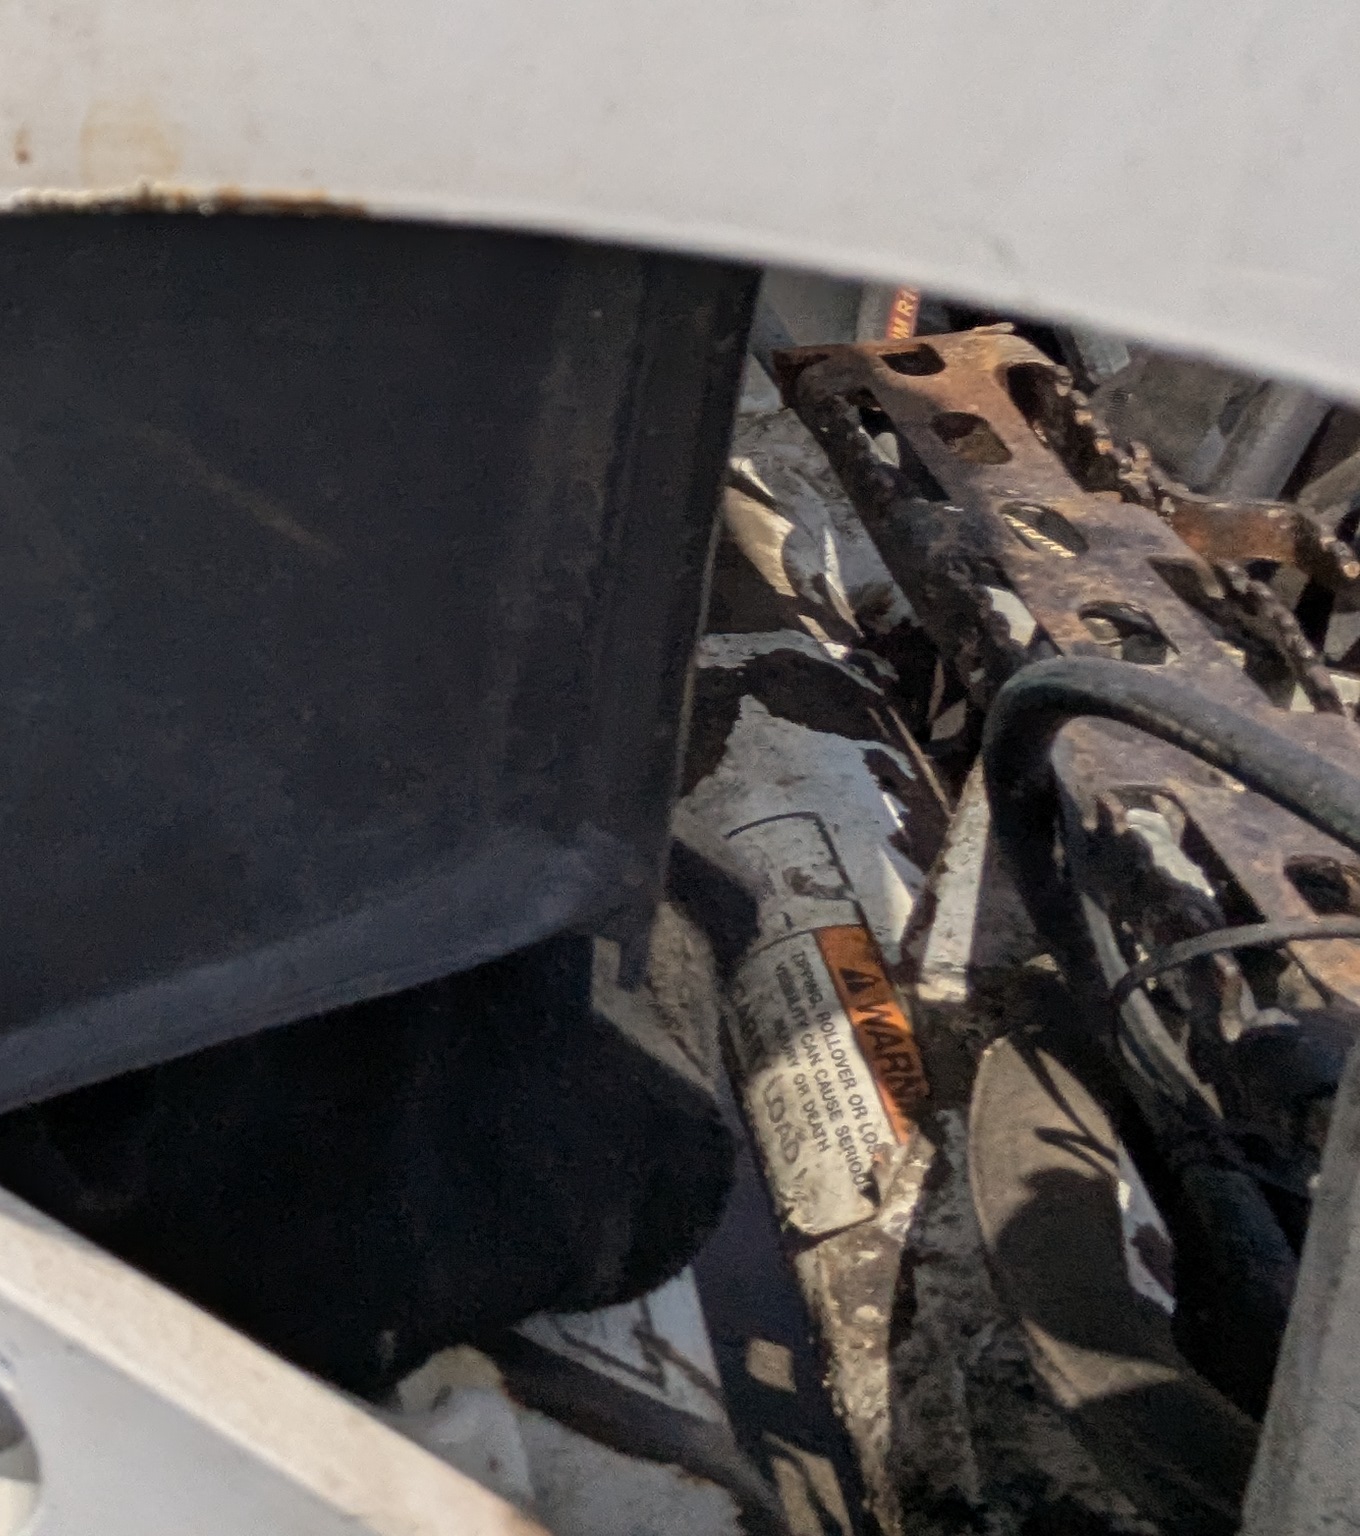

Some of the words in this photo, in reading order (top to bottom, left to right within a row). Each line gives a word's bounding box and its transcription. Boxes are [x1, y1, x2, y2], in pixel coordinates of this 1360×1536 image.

[792, 1072, 811, 1098] OR
[814, 1010, 858, 1090] ROLLOVER
[847, 1093, 869, 1120] OR
[858, 1121, 884, 1155] LOS
[858, 997, 923, 1110] WARN
[799, 1031, 823, 1066] CAN
[812, 1068, 844, 1122] CAUSE
[834, 1124, 873, 1191] SERIOU
[801, 1099, 832, 1153] DEATH
